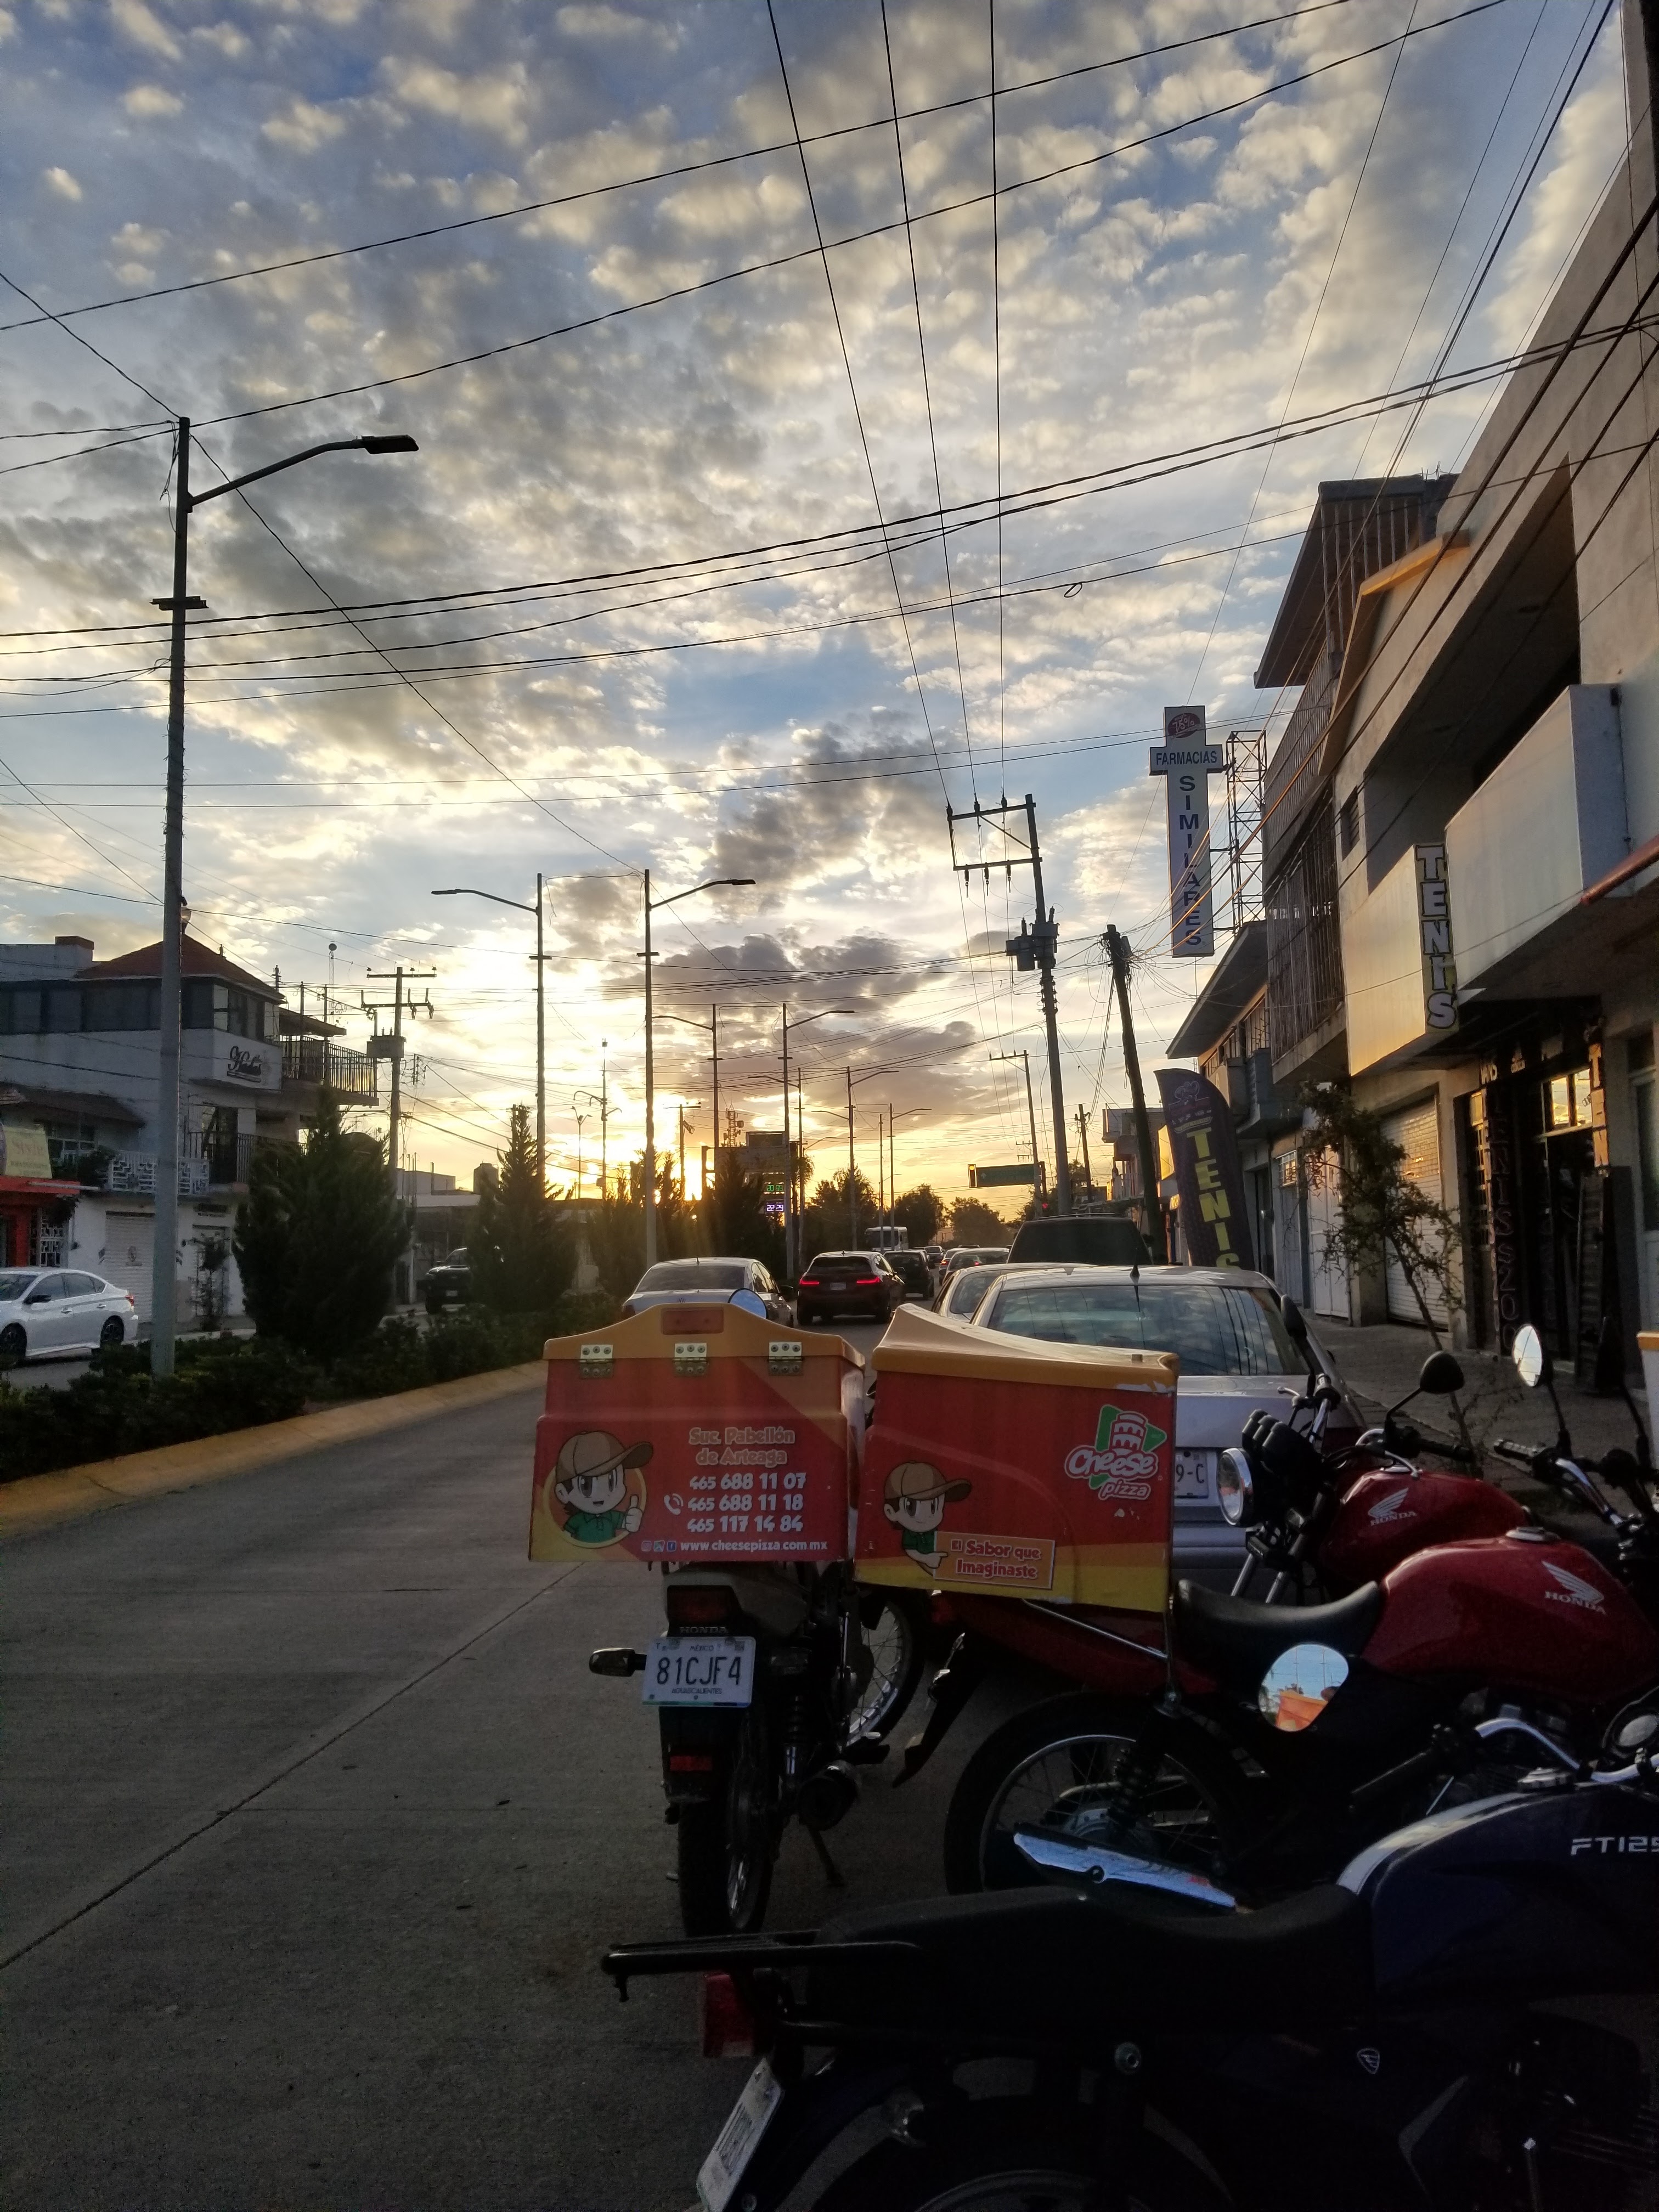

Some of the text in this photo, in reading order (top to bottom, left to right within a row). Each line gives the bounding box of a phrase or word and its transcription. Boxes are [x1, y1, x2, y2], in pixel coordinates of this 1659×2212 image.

[1172, 716, 1195, 733] 75%
[1156, 751, 1217, 765] FARMACIAS
[1179, 775, 1202, 946] SIMILARES
[1415, 844, 1457, 1029] TENIS
[689, 1426, 795, 1445] Suc. Pabellón
[696, 1447, 787, 1468] de Arteaga
[1068, 1449, 1155, 1476] Cheese
[690, 1472, 807, 1490] 465 688 11 07
[1175, 1463, 1205, 1483] 9-C
[1102, 1480, 1148, 1497] pizza
[687, 1494, 804, 1511] 465 688 11 18
[687, 1515, 803, 1532] 465 117 14 84
[1370, 1511, 1417, 1526] HONDA
[680, 1539, 828, 1552] www.cheesepizza.com.mx
[951, 1539, 1041, 1561] El Sabor que
[957, 1559, 1038, 1579] Imaginaste
[1545, 1591, 1607, 1616] HONDA
[657, 1657, 741, 1685] 81CJF4
